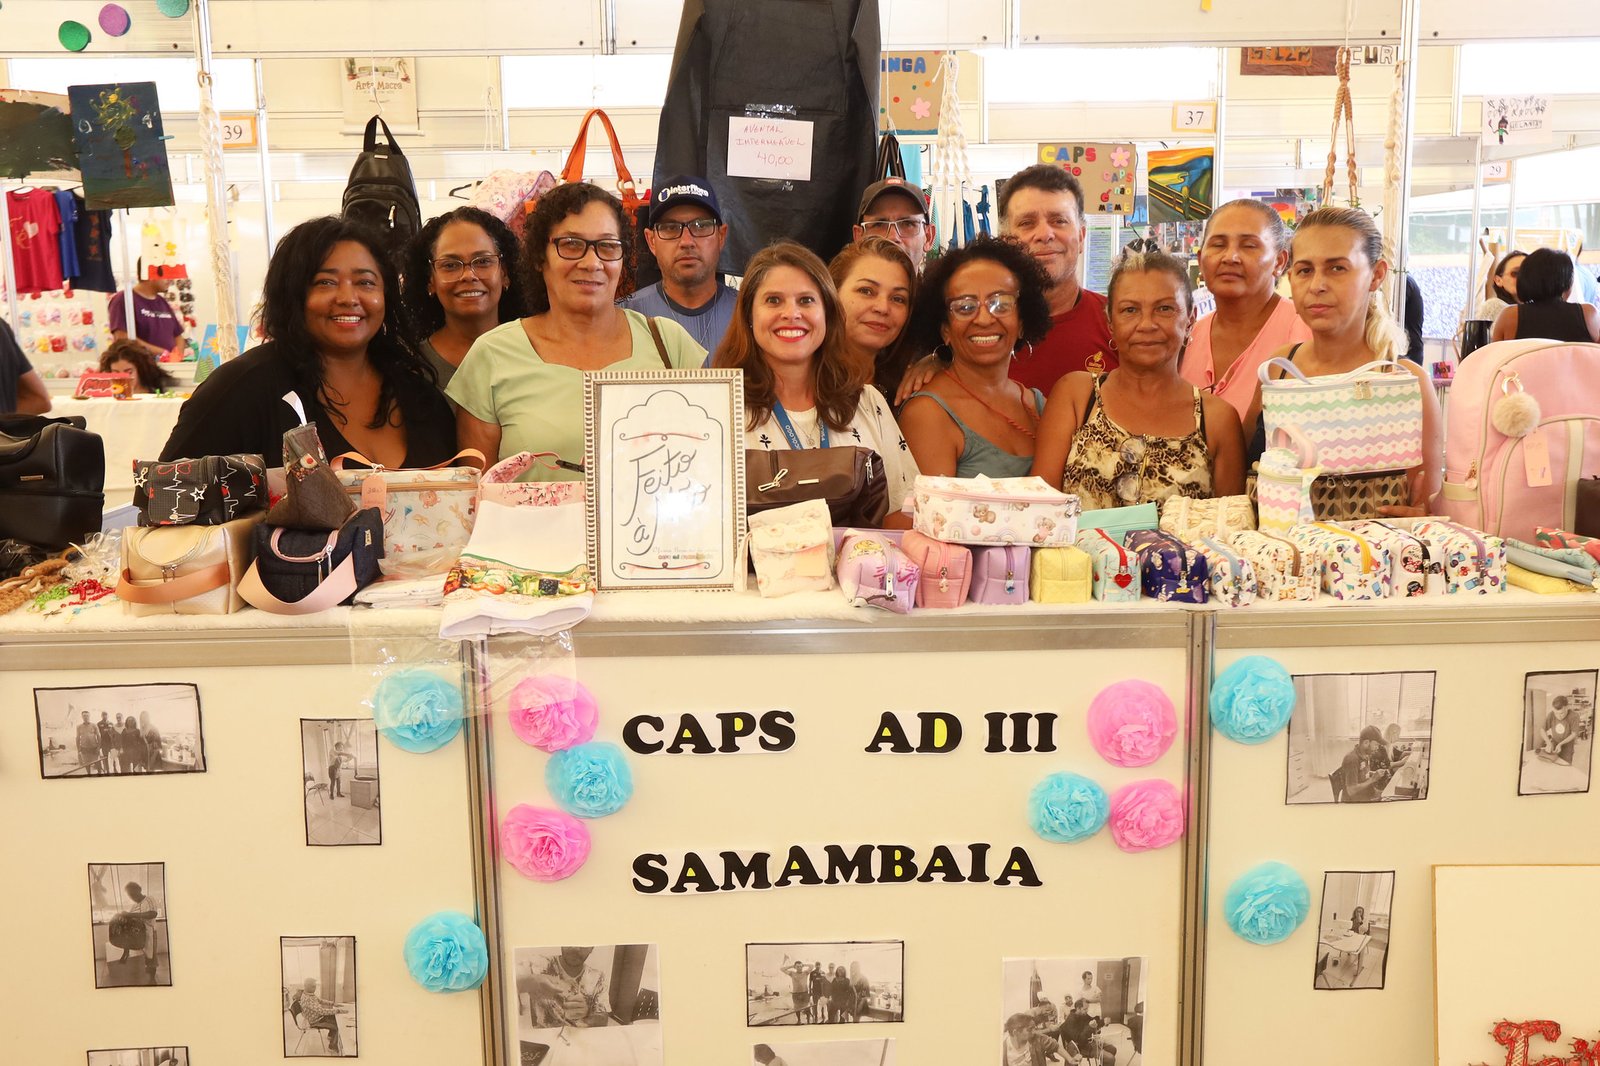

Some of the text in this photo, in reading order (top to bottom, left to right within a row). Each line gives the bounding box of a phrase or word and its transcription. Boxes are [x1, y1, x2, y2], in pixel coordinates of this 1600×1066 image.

[1184, 110, 1204, 126] 37
[223, 125, 243, 140] 39
[757, 151, 794, 167] 40,00
[1041, 145, 1096, 164] CAPS
[1103, 169, 1133, 182] CAPS
[620, 443, 697, 527] Feito
[622, 710, 1058, 755] CAPS AD III
[632, 843, 1043, 893] SAMAMBAIA
